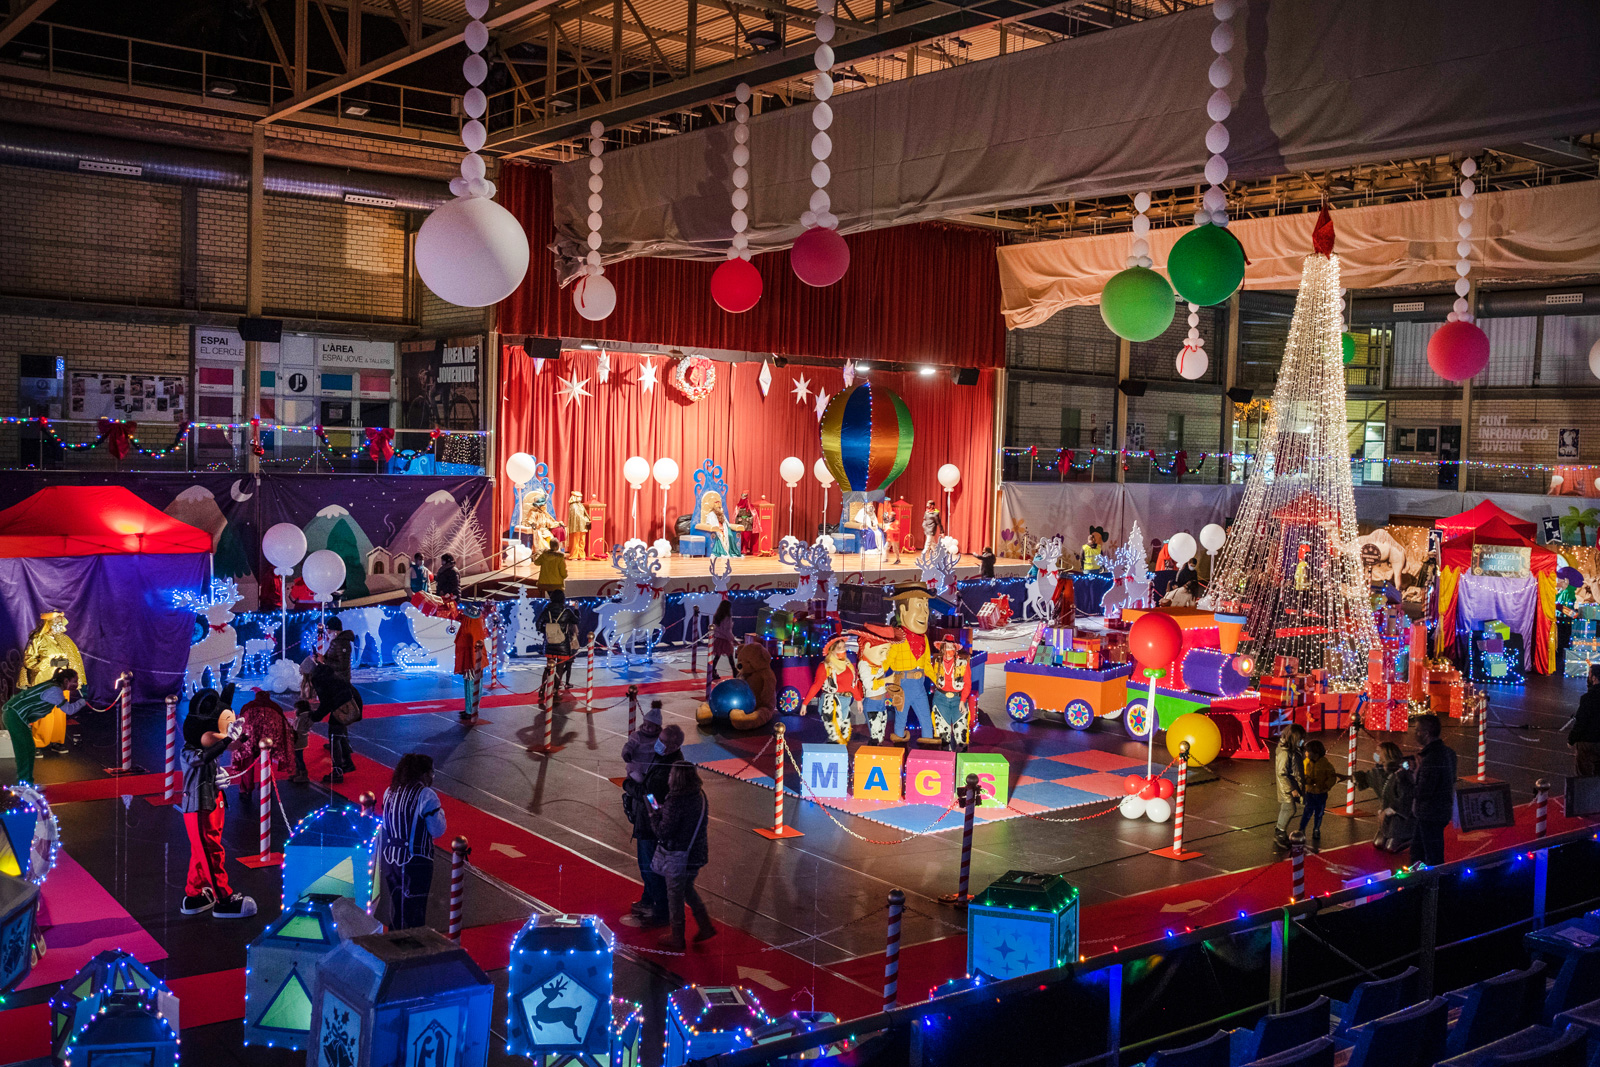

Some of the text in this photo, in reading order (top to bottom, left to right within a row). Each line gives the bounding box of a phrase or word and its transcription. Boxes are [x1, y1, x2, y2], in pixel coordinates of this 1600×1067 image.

[200, 336, 229, 346] ESPAI
[200, 346, 245, 357] EL CERCLE
[322, 343, 354, 353] L'ÀREA
[442, 343, 476, 364] ÀREA DE
[322, 353, 343, 362] ESPAI
[344, 355, 364, 363] JOVE
[437, 365, 476, 383] JOVENTUT
[1479, 415, 1508, 427] PUNT
[1478, 426, 1549, 440] INFORMACIÓ
[1478, 441, 1524, 452] JUVENIL
[1483, 553, 1522, 561] MAGATZEM
